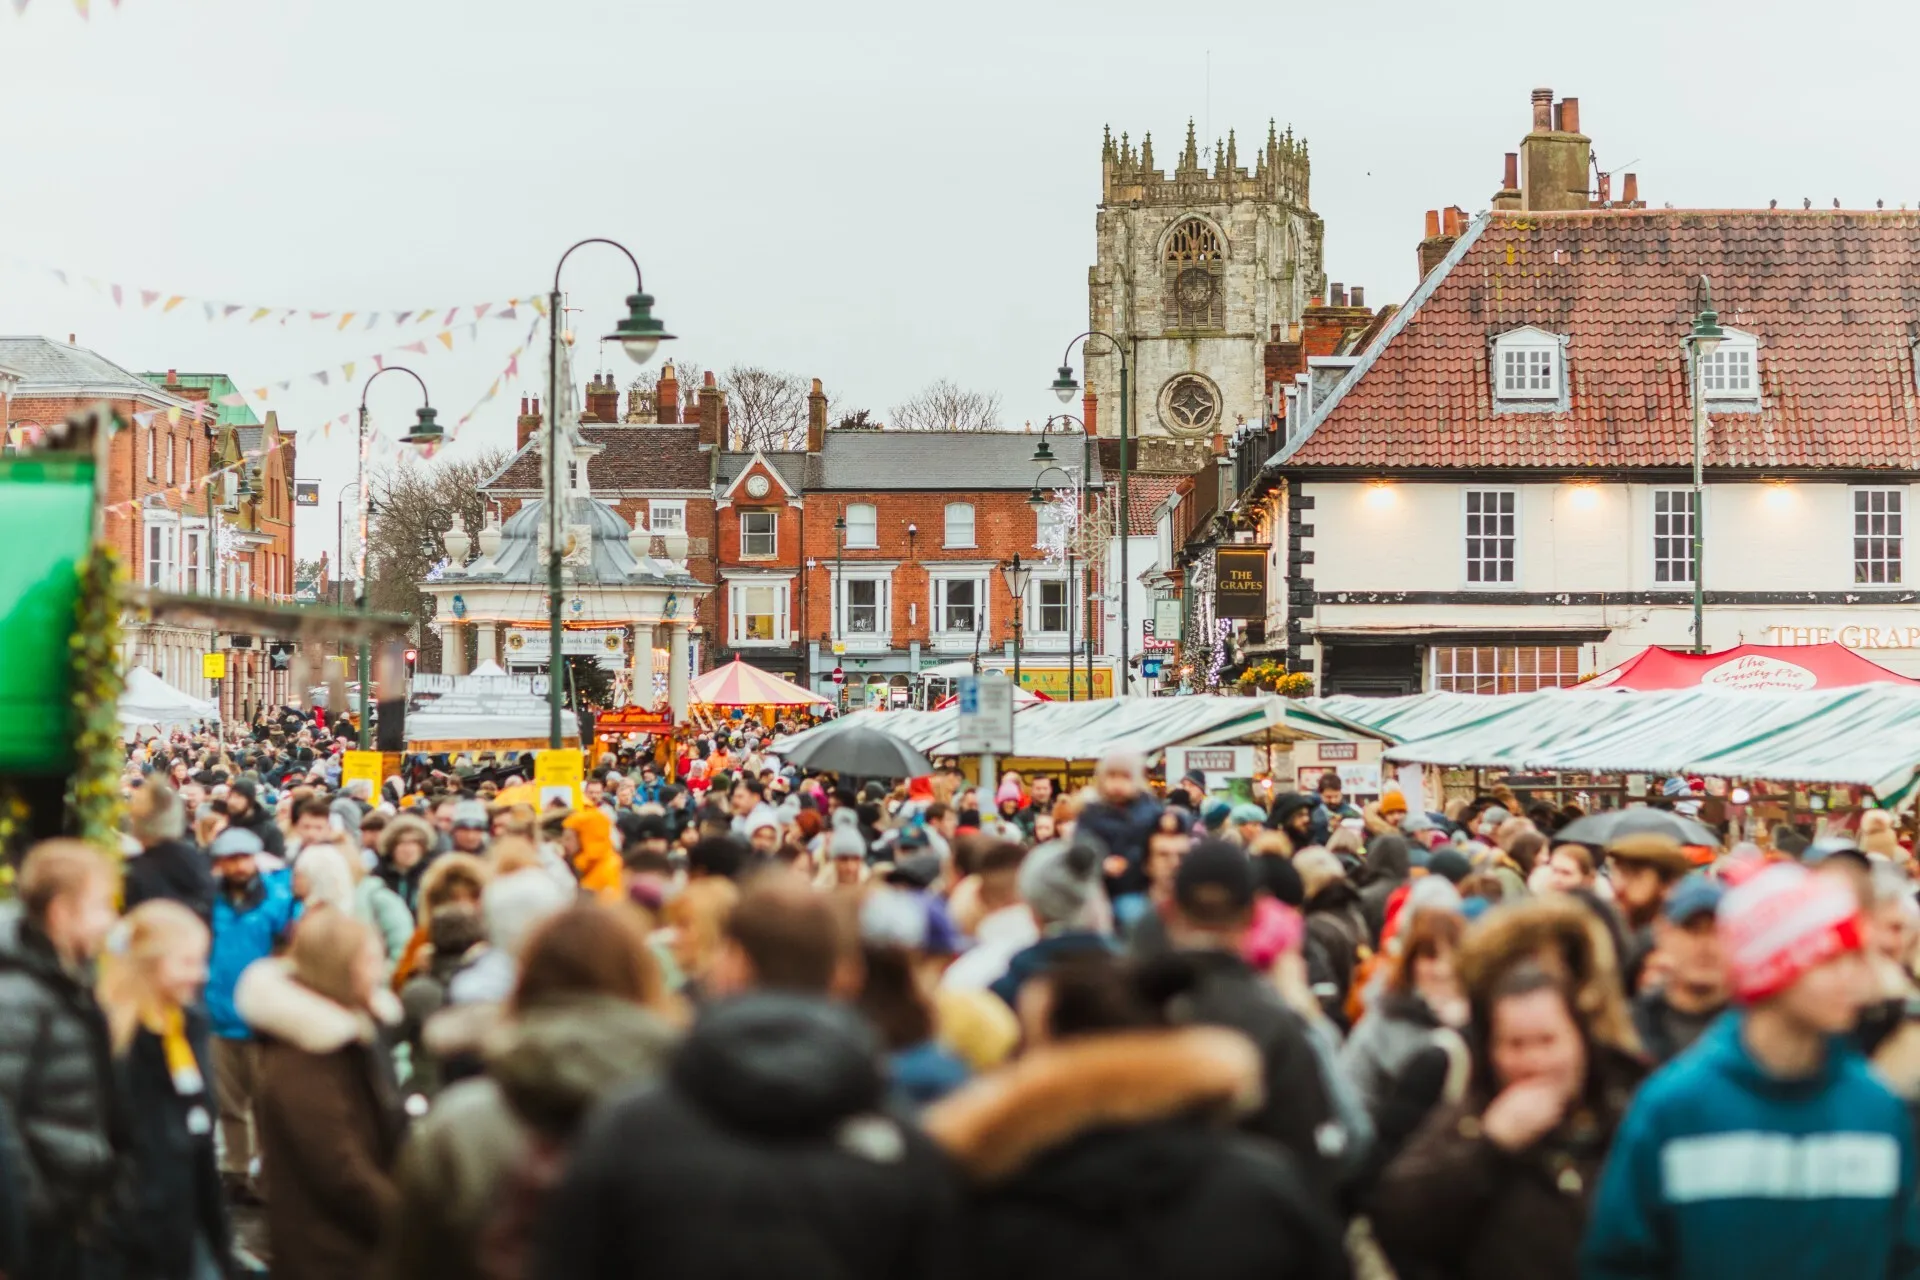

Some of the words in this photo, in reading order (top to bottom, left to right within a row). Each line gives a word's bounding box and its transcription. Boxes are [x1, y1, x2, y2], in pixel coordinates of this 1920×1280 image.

[1230, 570, 1252, 579] THE
[1220, 581, 1262, 590] GRAPES
[1769, 626, 1831, 646] THE
[1838, 625, 1920, 648] GRAP
[1737, 657, 1768, 669] The
[1712, 669, 1770, 683] Crusty
[1775, 668, 1803, 678] Pie
[1321, 750, 1354, 758] BAKERY
[1189, 759, 1230, 769] BAKERY
